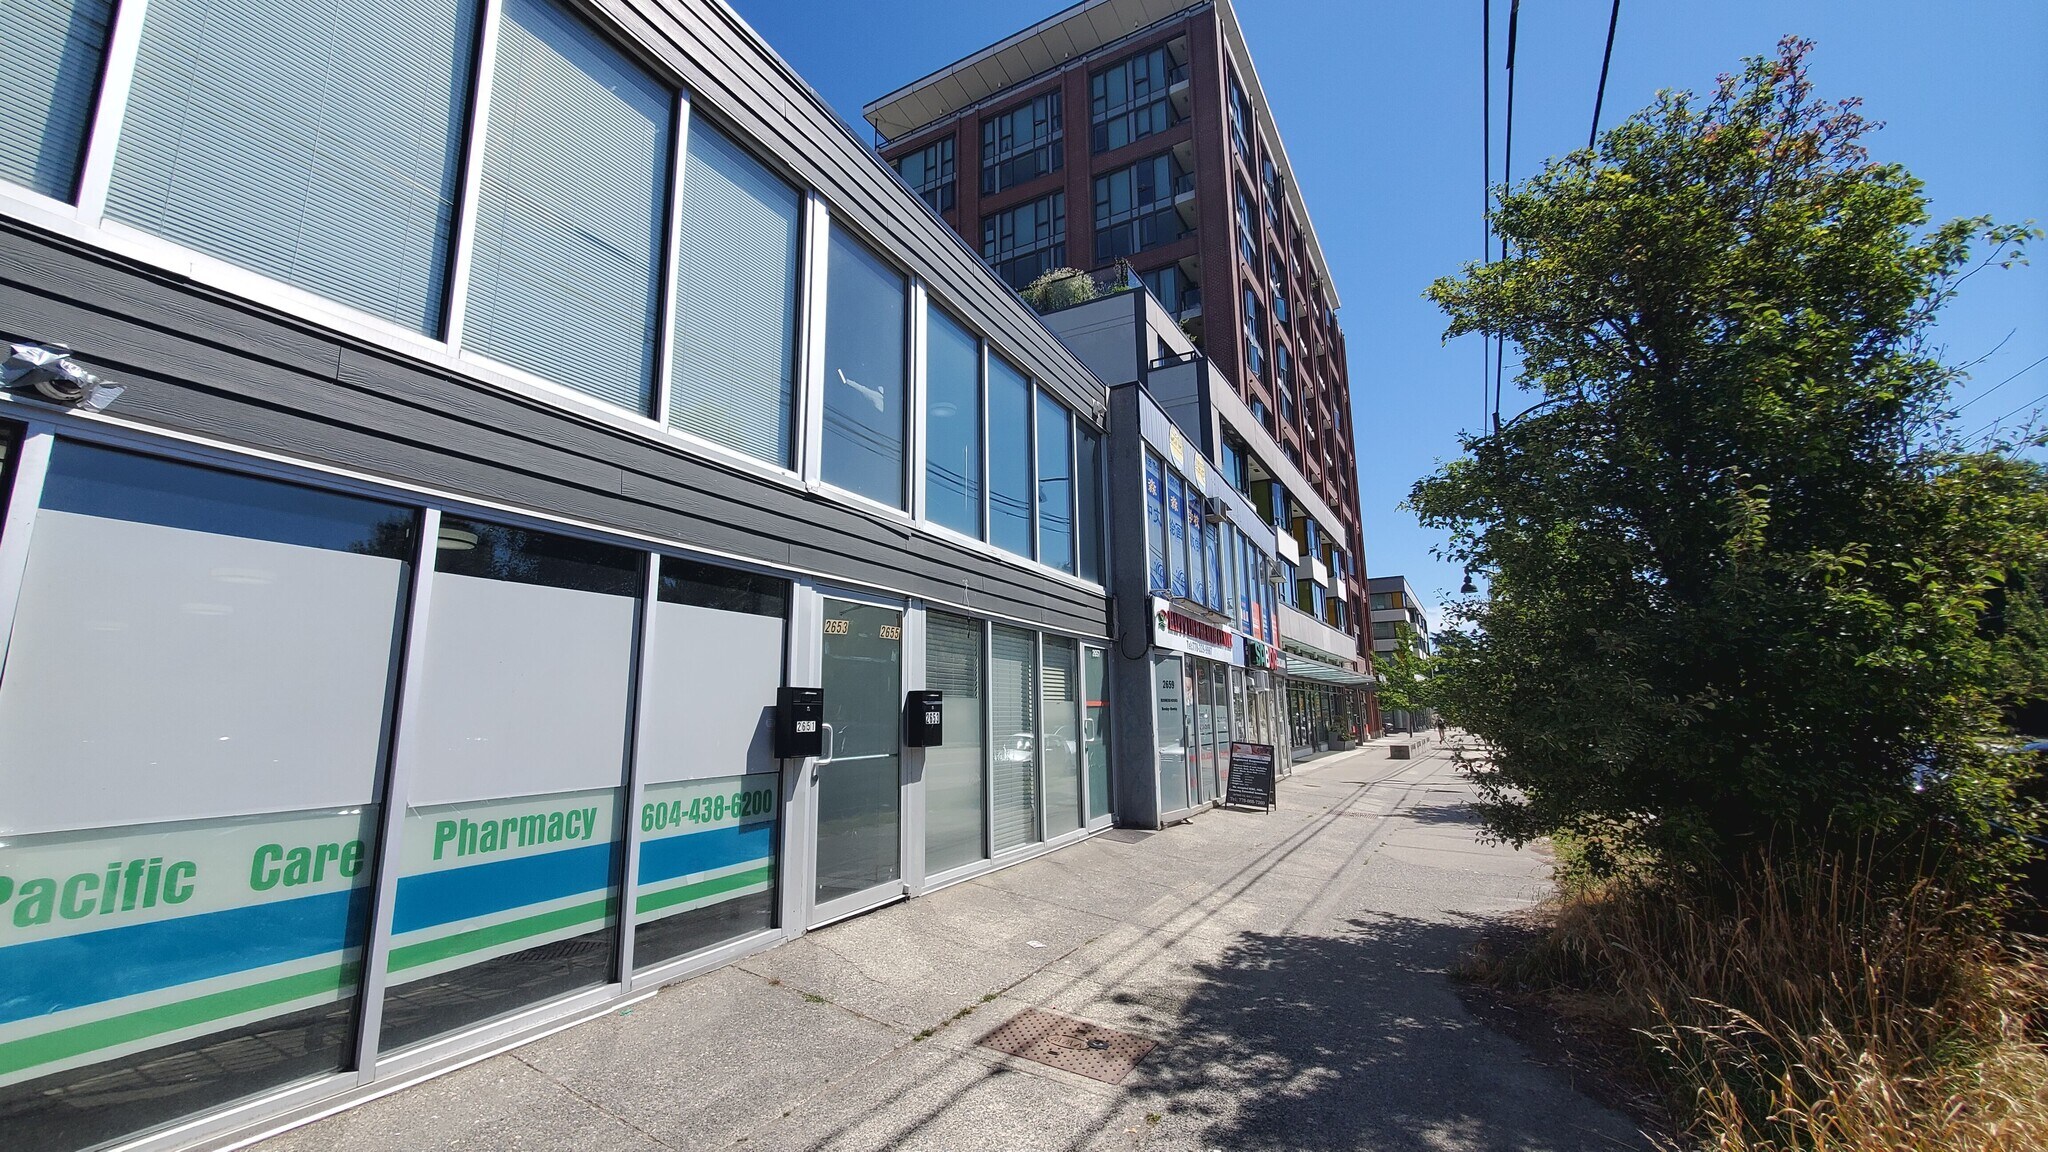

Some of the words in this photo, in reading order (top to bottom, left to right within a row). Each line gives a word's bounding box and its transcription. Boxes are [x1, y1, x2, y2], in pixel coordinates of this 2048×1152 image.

[825, 620, 848, 633] 2653
[880, 626, 900, 639] 2655
[1162, 680, 1175, 689] 2659
[797, 721, 816, 732] 2651
[641, 789, 773, 832] 604-438-6200
[249, 840, 366, 891] Care
[433, 807, 597, 860] Pharmacy
